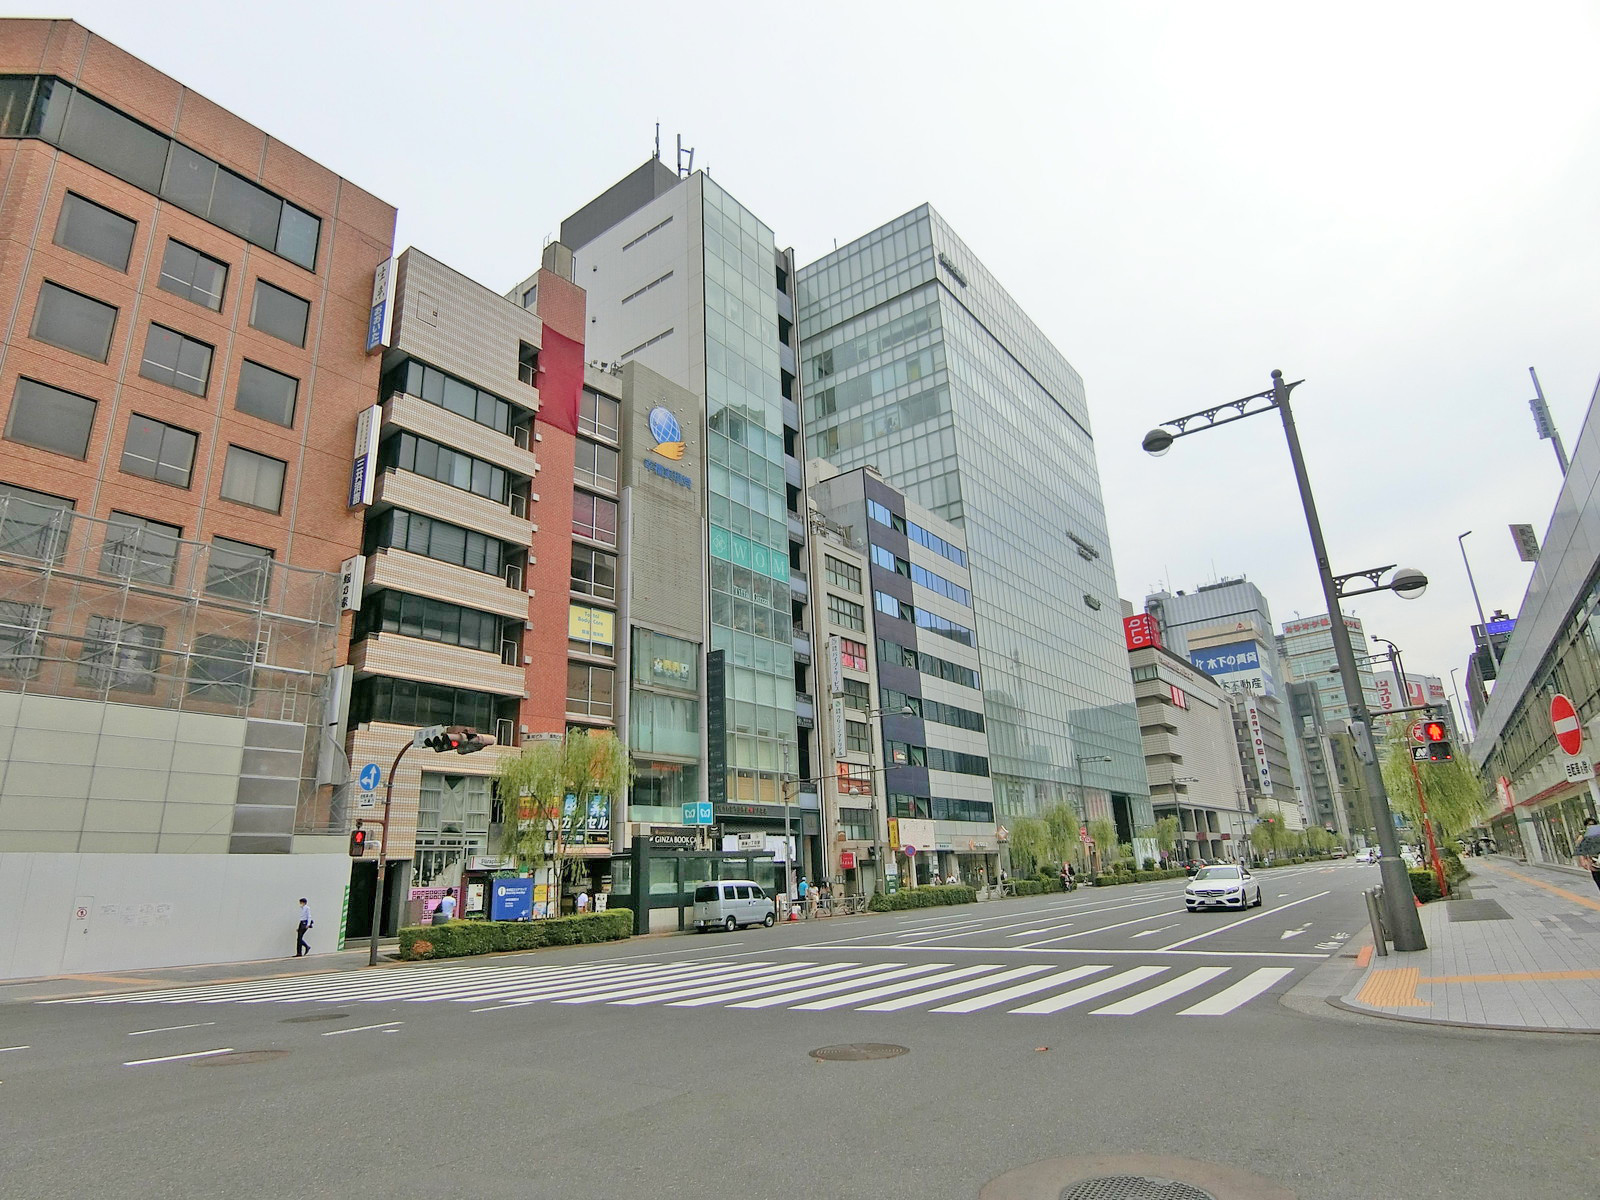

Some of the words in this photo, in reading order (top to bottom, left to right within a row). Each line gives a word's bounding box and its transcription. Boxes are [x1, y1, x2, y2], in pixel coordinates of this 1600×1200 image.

[1207, 652, 1258, 670] 木下の賃貸
[655, 836, 674, 844] GINZA
[674, 836, 690, 844] BOOK
[690, 836, 703, 844] CAE
